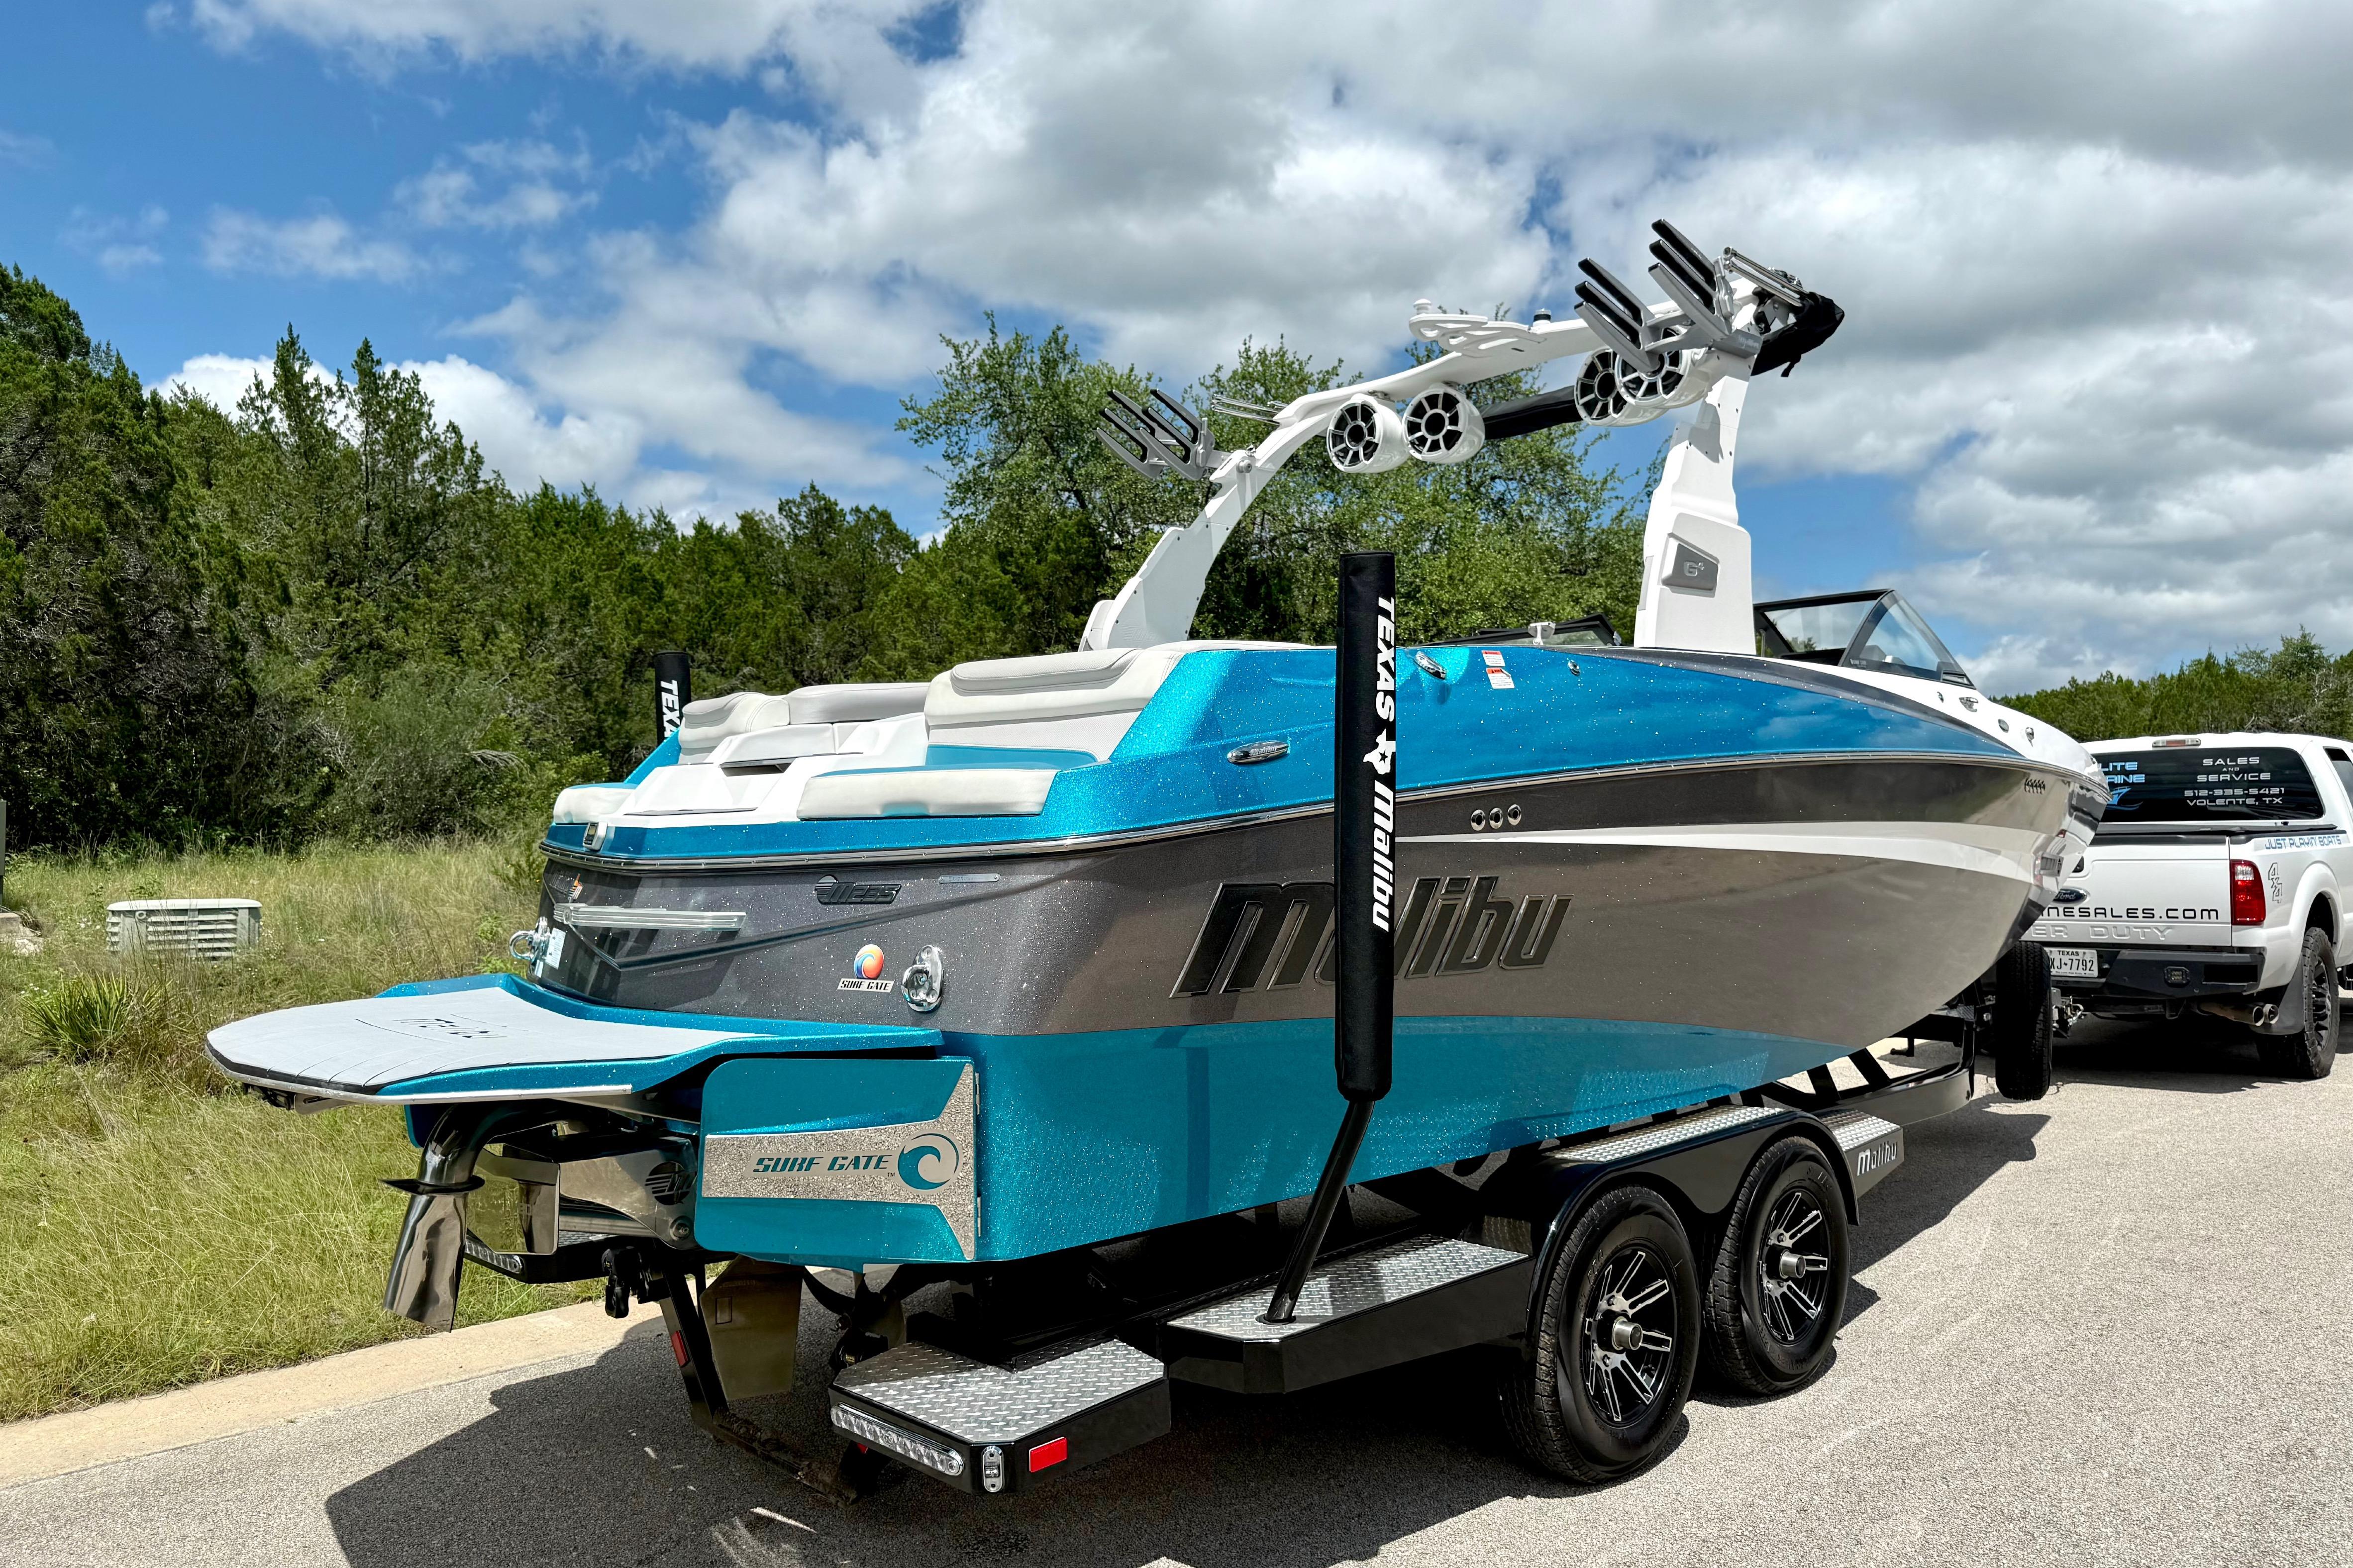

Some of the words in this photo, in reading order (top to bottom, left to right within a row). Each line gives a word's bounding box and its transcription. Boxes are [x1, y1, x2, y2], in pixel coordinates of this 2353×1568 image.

[1375, 596, 1395, 723] TEXAS
[661, 680, 681, 738] TEXA
[2099, 762, 2138, 771] LITE
[2203, 757, 2259, 766] SALES
[2197, 773, 2271, 782] SERVICE
[2184, 787, 2285, 796] 512-335-5421
[2265, 838, 2287, 850] JUST
[2318, 836, 2342, 846] BOATS
[1372, 780, 1394, 933] Malibu
[1169, 875, 1574, 998] Mlibu
[2090, 926, 2173, 940] DUTY
[867, 981, 891, 990] GATE
[753, 1157, 824, 1173] SURF
[827, 1154, 892, 1171] GATE
